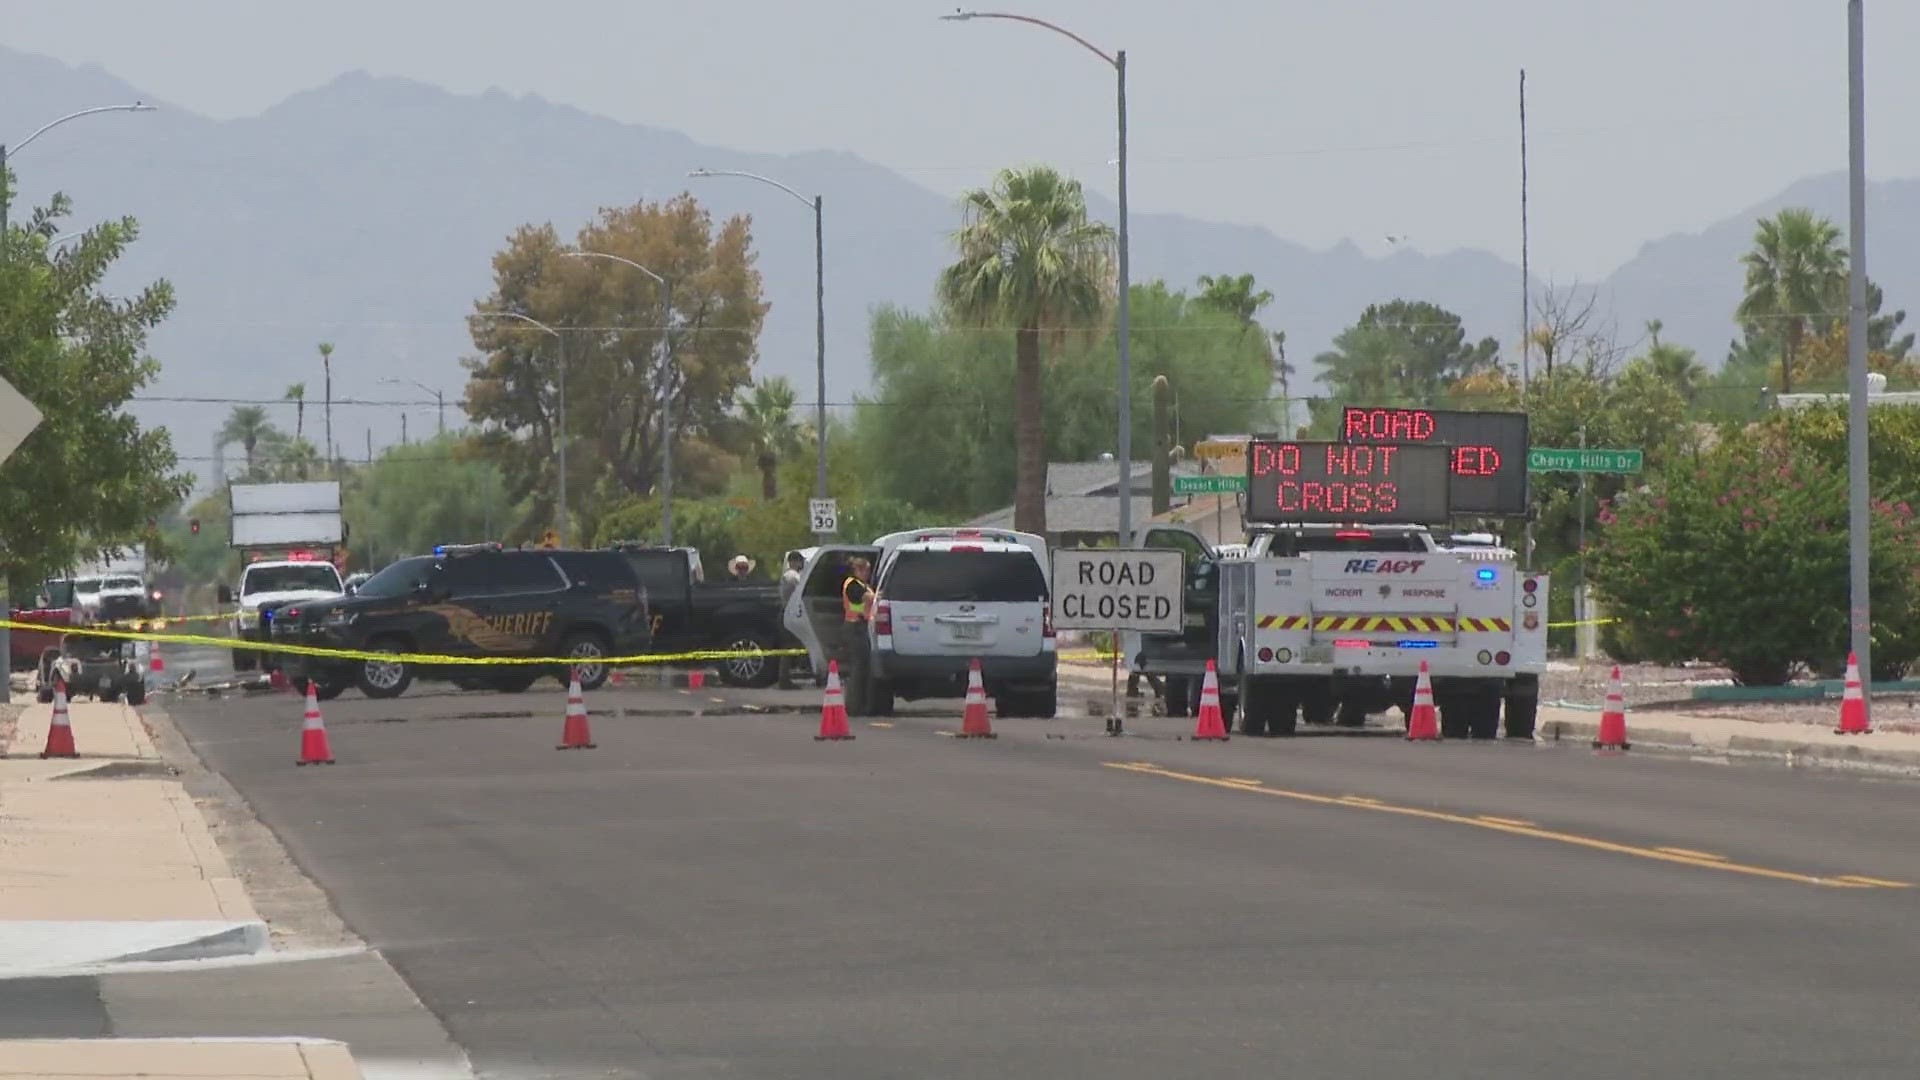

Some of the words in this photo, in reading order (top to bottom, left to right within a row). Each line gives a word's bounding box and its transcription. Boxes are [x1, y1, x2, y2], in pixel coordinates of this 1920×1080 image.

[1346, 410, 1435, 439] ROAD
[1253, 444, 1300, 475] DO
[1327, 445, 1397, 475] NOT
[1531, 452, 1574, 468] Cherry
[1580, 454, 1611, 467] Hills
[1617, 455, 1633, 469] Dr
[1277, 480, 1397, 512] CROSS
[814, 515, 834, 529] 30
[1079, 561, 1155, 586] ROAD
[1343, 559, 1426, 574] REACT
[1324, 588, 1363, 598] INCIDENT
[1402, 588, 1446, 598] RESPONSE
[1063, 594, 1171, 619] CLOSED
[485, 610, 554, 635] SHERIFF
